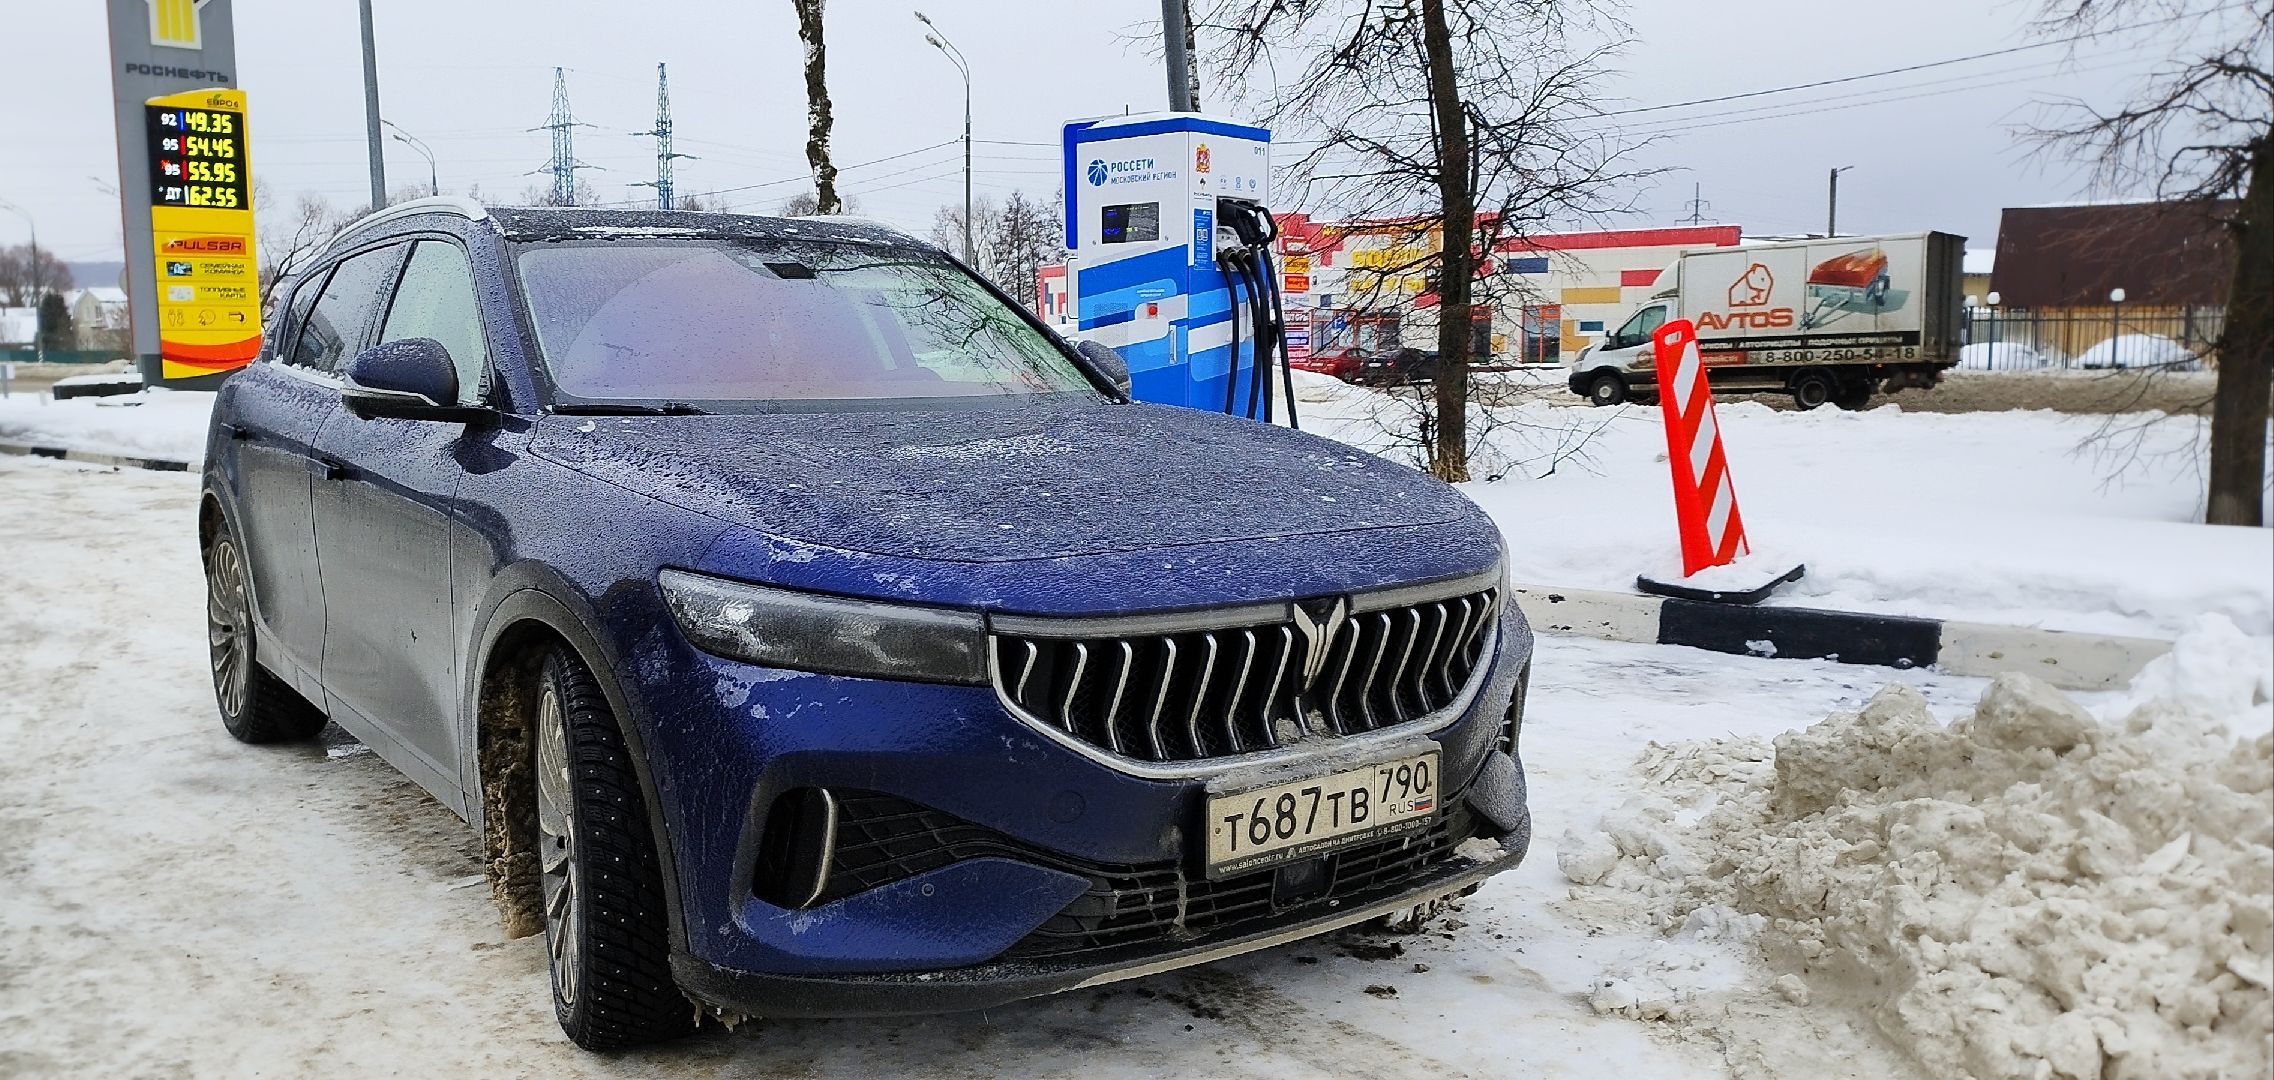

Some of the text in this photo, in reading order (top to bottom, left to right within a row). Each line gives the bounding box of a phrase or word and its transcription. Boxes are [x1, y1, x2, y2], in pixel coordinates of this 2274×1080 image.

[125, 63, 229, 82] РОСНЕФТЬ
[161, 112, 232, 133] 92 49.35
[162, 136, 235, 158] 95 54.45
[164, 161, 236, 183] 95 55.95
[1111, 158, 1154, 172] РОССЕТИ
[1111, 170, 1177, 184] МОСКОВСКИЙ РЕГИОН
[165, 186, 237, 208] ДТ 62.55
[170, 240, 242, 251] PULSAR
[1695, 308, 1793, 330] AVTOS
[1699, 342, 1733, 350] АРКОПЫ
[1738, 339, 1802, 349] АВТОПРИЦЕПЫ
[1224, 760, 1430, 852] Т687ТВ 790
[1389, 801, 1414, 817] RUS
